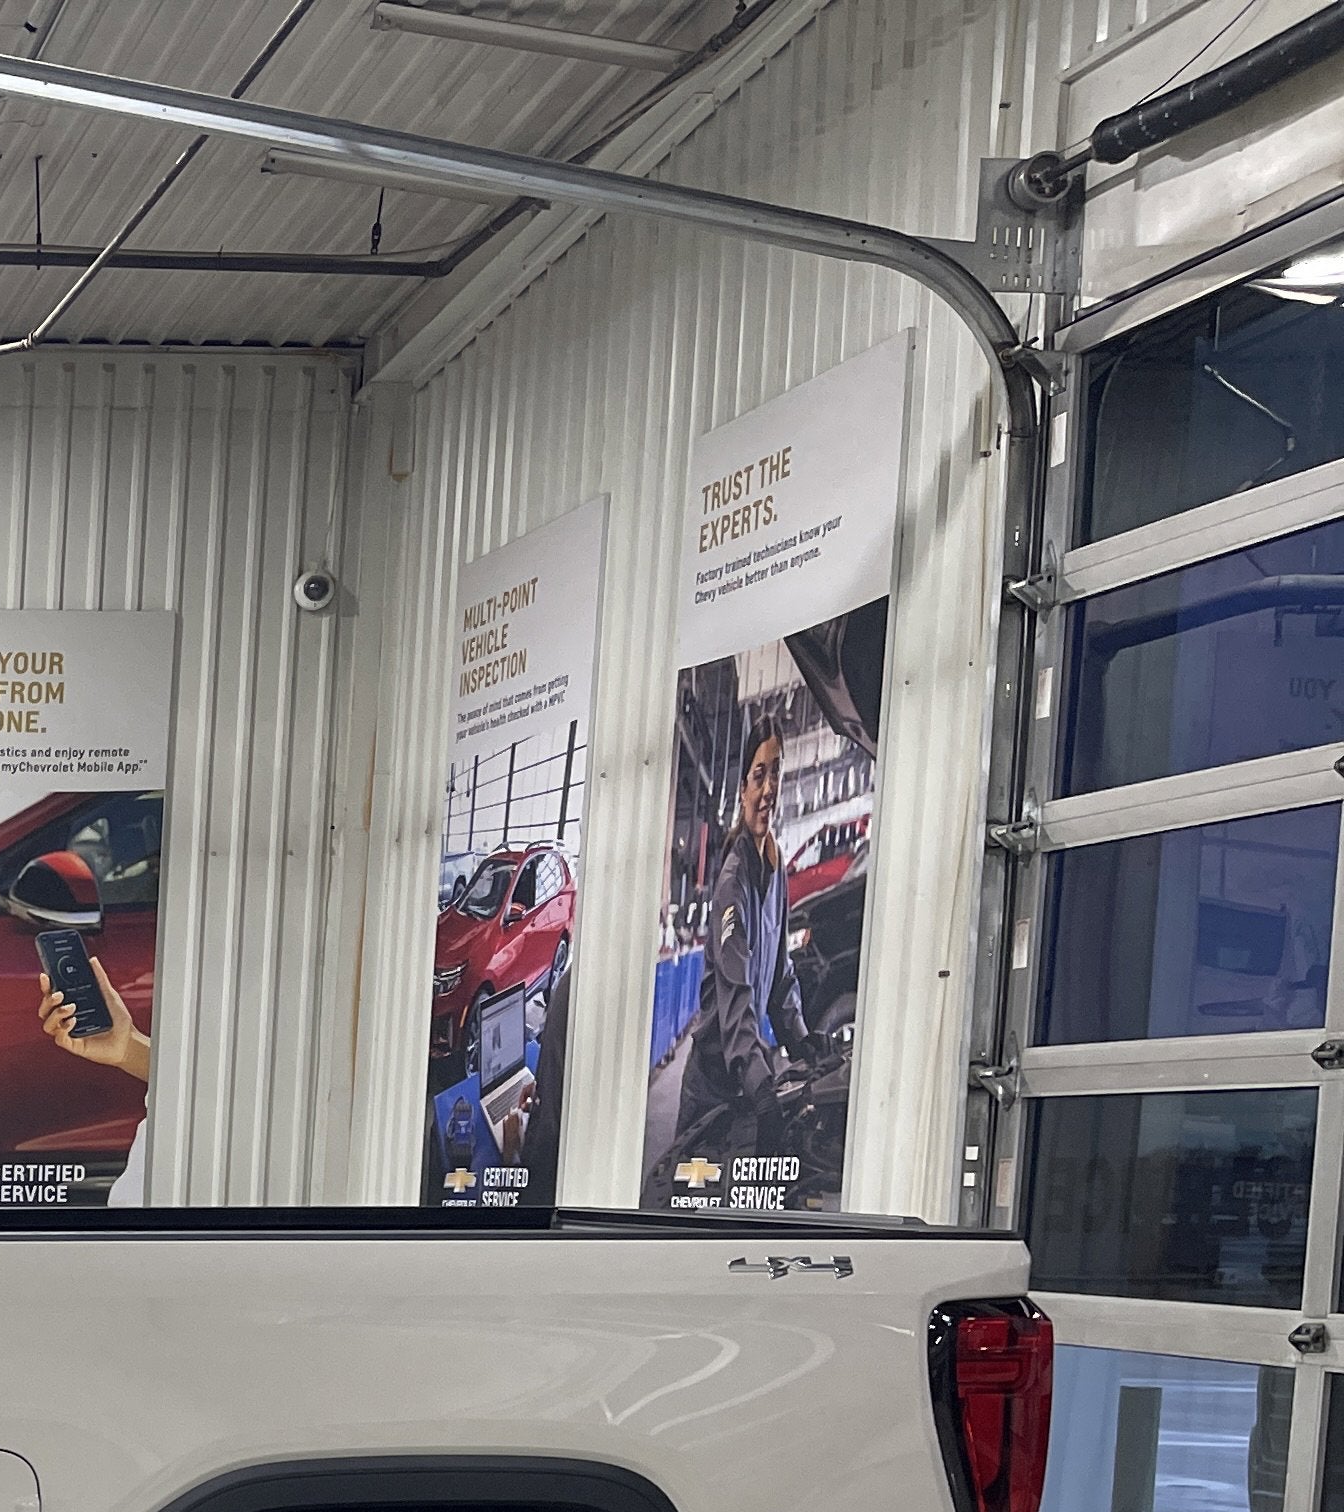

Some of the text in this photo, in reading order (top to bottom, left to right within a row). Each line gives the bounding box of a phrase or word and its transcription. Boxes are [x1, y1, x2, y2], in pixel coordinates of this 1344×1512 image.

[702, 446, 792, 515] TRUST THE
[699, 495, 778, 553] EXPERTS.
[695, 515, 842, 586] Factory trained technicians know your
[694, 588, 716, 605] Chevy
[718, 576, 743, 596] vehicle
[745, 567, 769, 586] better
[770, 559, 788, 577] than
[464, 577, 539, 633] MULTI-POINT
[462, 623, 509, 665] VEHICLE
[459, 648, 528, 698] INSPECTION
[1, 761, 74, 774] myChevrolet
[77, 761, 114, 773] Mobile
[31, 747, 51, 757] and
[54, 747, 85, 760] enjoy
[88, 748, 130, 757] remote
[483, 1167, 528, 1187] CERTIFIED
[732, 1156, 800, 1181] CERTIFIED
[481, 1191, 519, 1207] SERVICE
[729, 1186, 786, 1210] SERVICE
